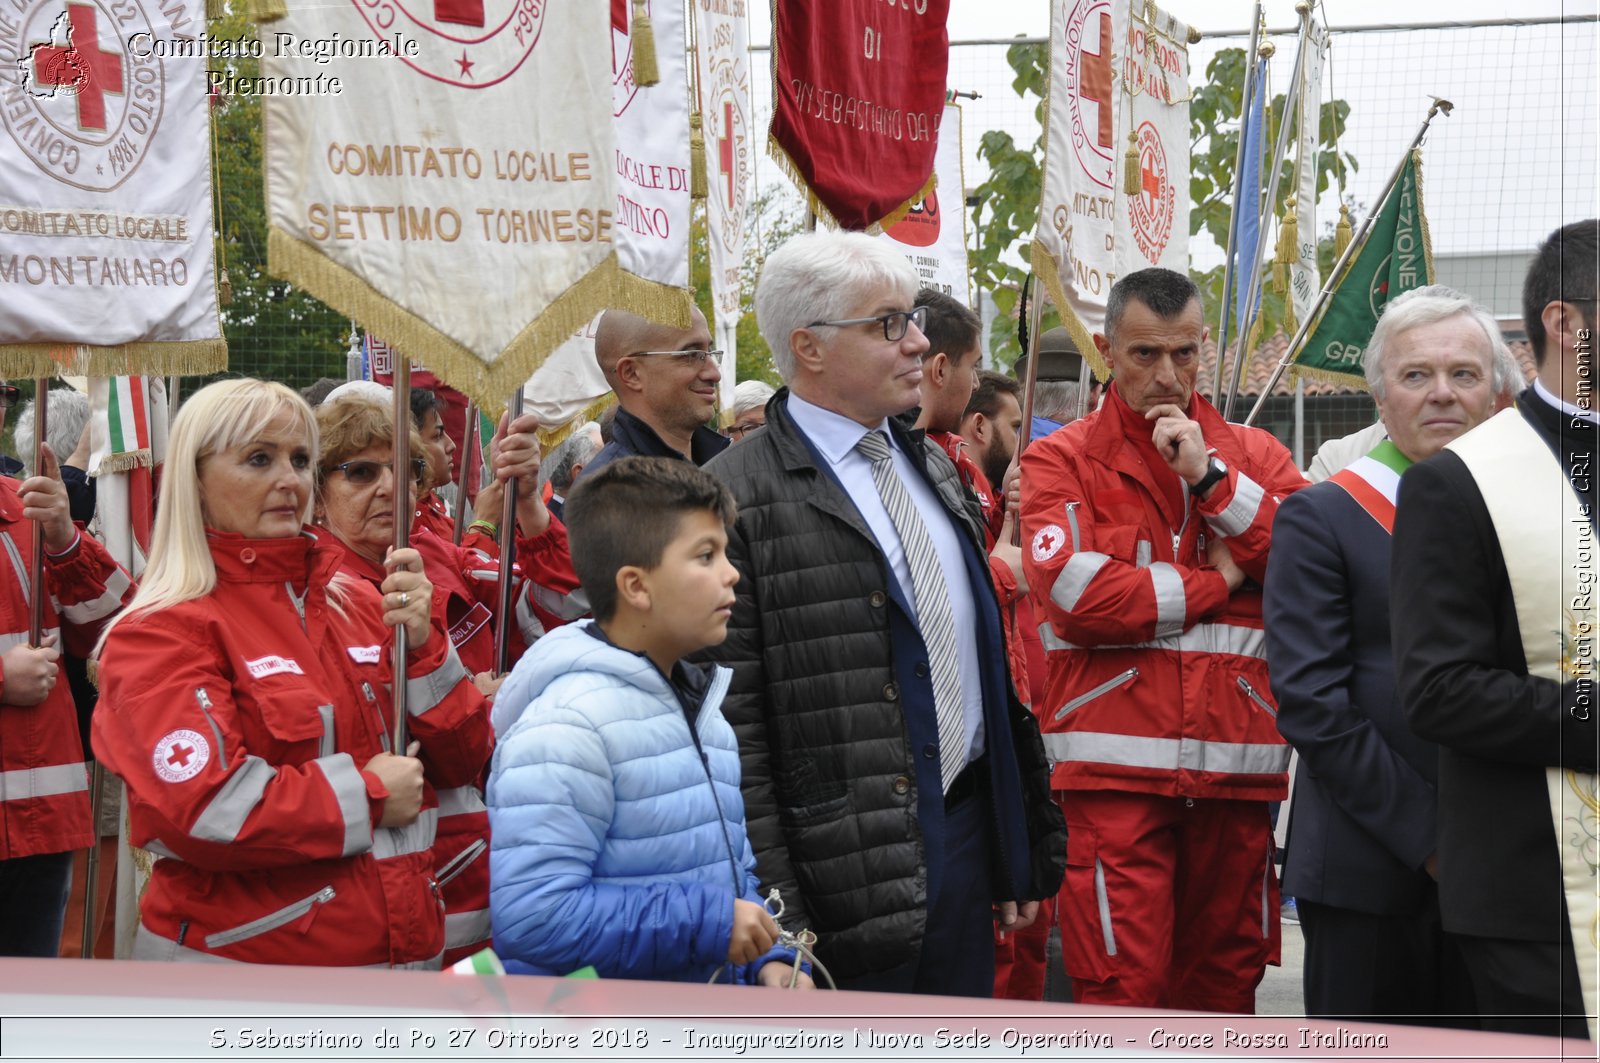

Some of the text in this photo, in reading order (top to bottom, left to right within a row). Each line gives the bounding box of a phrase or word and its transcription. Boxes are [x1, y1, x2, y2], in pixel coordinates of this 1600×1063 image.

[863, 26, 882, 62] DI
[814, 88, 902, 141] SEBASTIANO
[906, 112, 929, 142] DA
[326, 142, 592, 182] COMITATO LOCALE
[667, 166, 689, 192] DI
[0, 210, 188, 241] OMITATO LOCALE
[306, 202, 613, 244] SETTIMO TORINESE
[0, 254, 188, 287] MONTANARO
